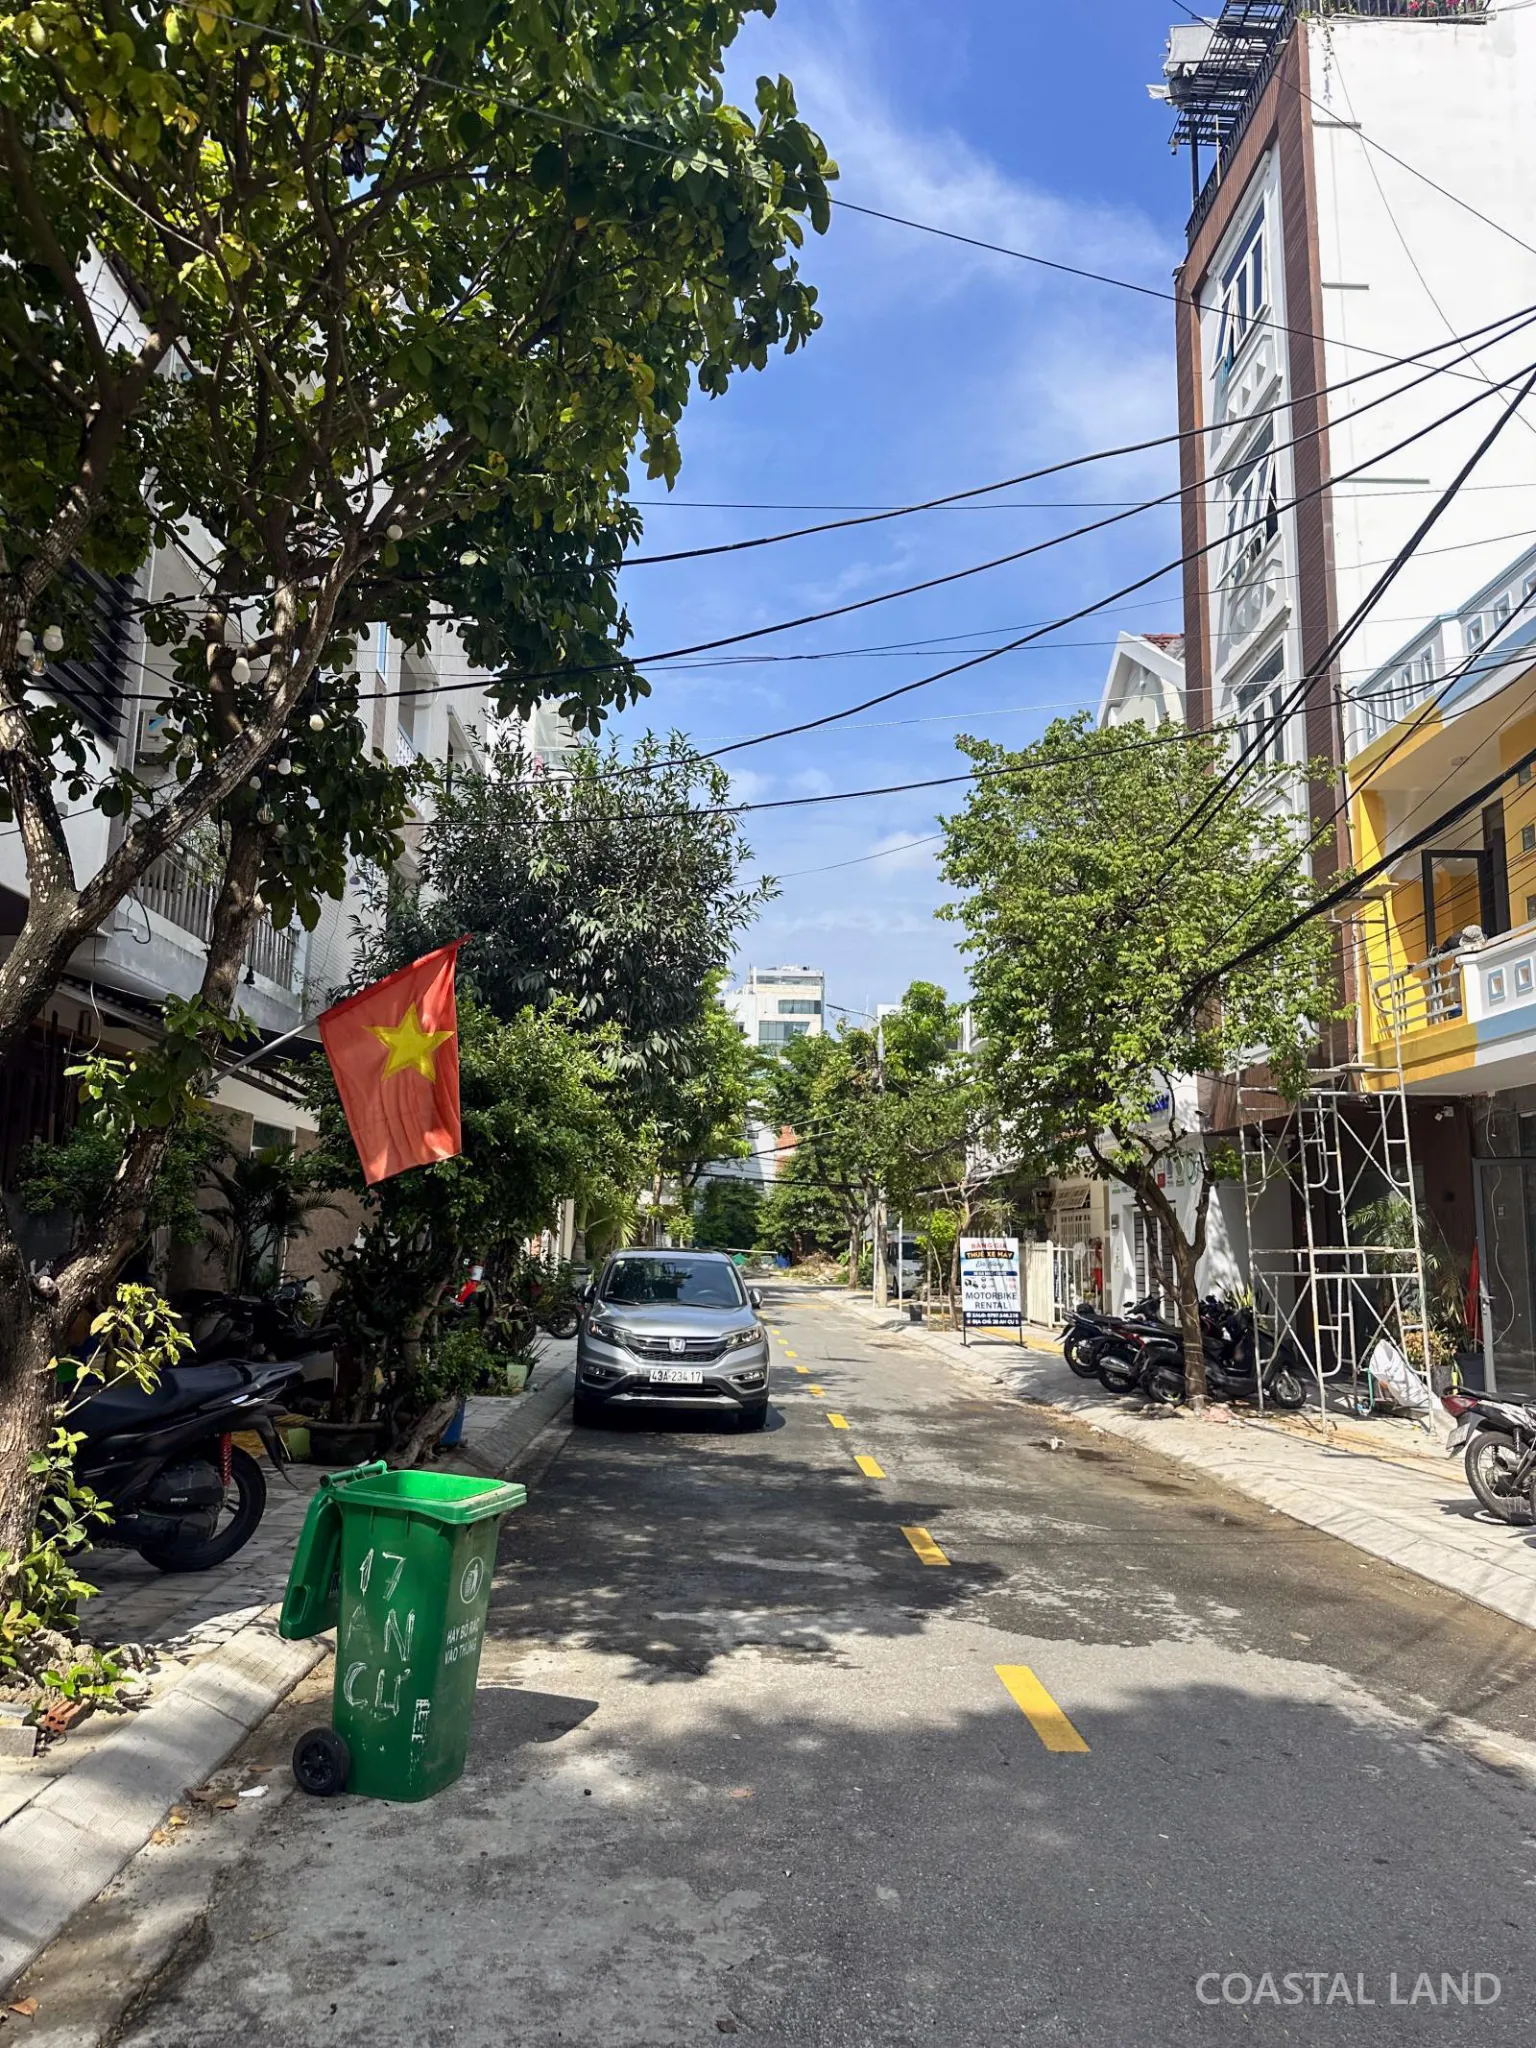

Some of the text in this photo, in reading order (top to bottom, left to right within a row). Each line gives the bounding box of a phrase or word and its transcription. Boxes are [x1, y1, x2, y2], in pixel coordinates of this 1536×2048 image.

[965, 1292, 1017, 1300] MOTORBIKE
[974, 1301, 1008, 1309] RENTAL
[359, 1547, 407, 1601] 17
[345, 1603, 415, 1662] AN
